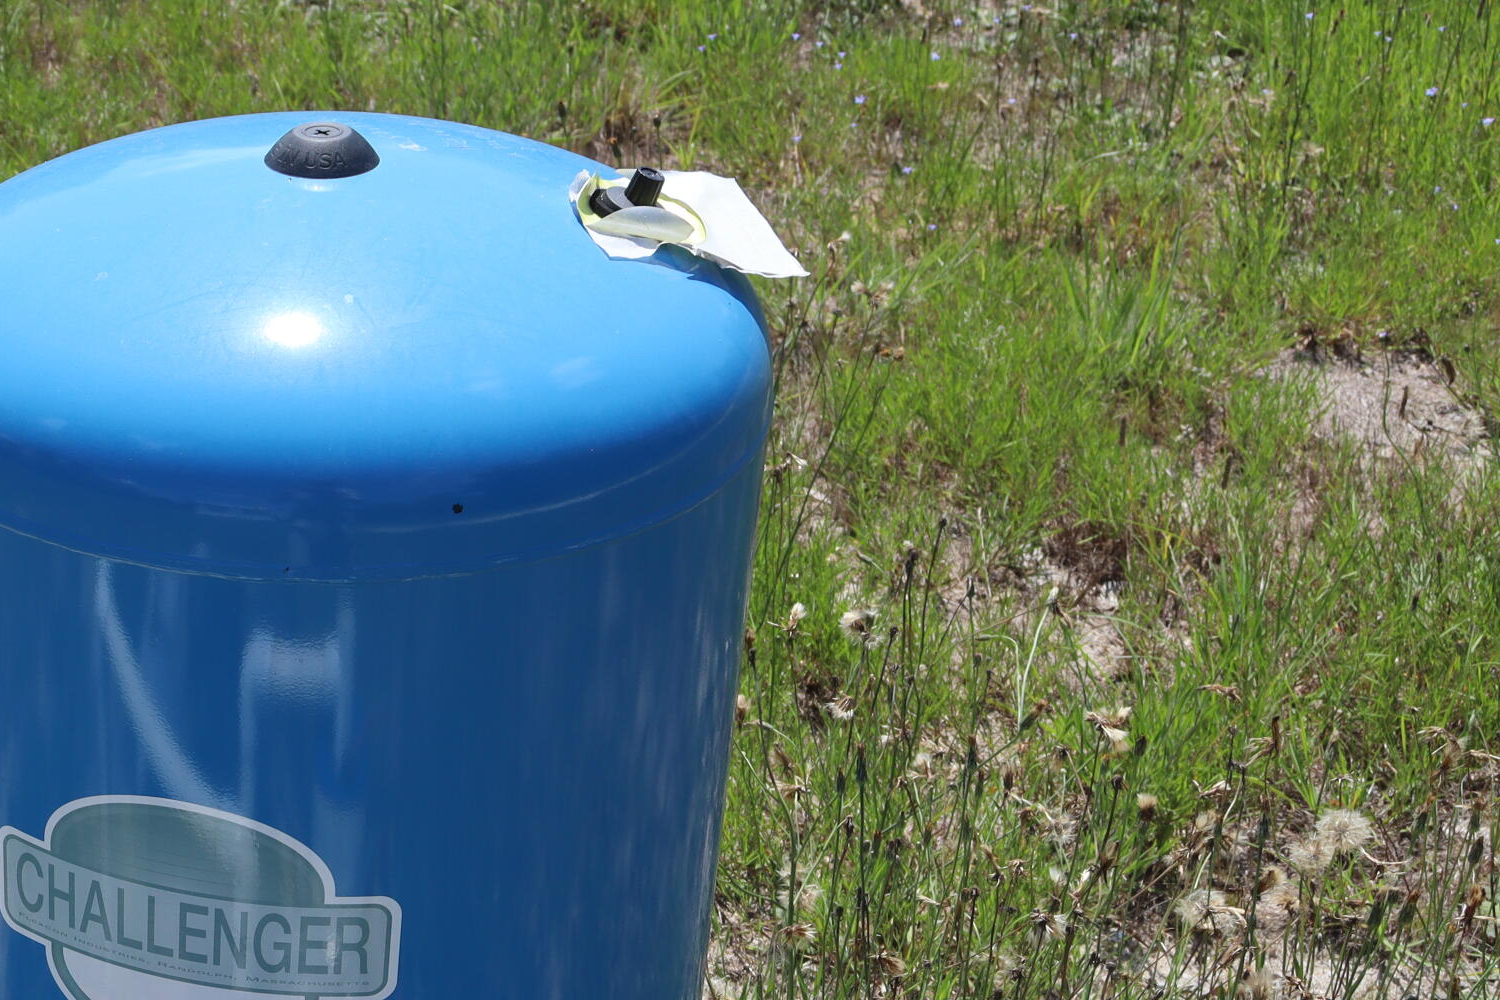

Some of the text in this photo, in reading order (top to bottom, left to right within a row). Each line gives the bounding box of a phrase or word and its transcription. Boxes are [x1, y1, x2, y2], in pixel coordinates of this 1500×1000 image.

[304, 151, 348, 170] USA
[17, 852, 371, 975] CHALLENGER
[18, 911, 68, 938] FLEXCON
[246, 976, 370, 986] MASSACHUSETTS
